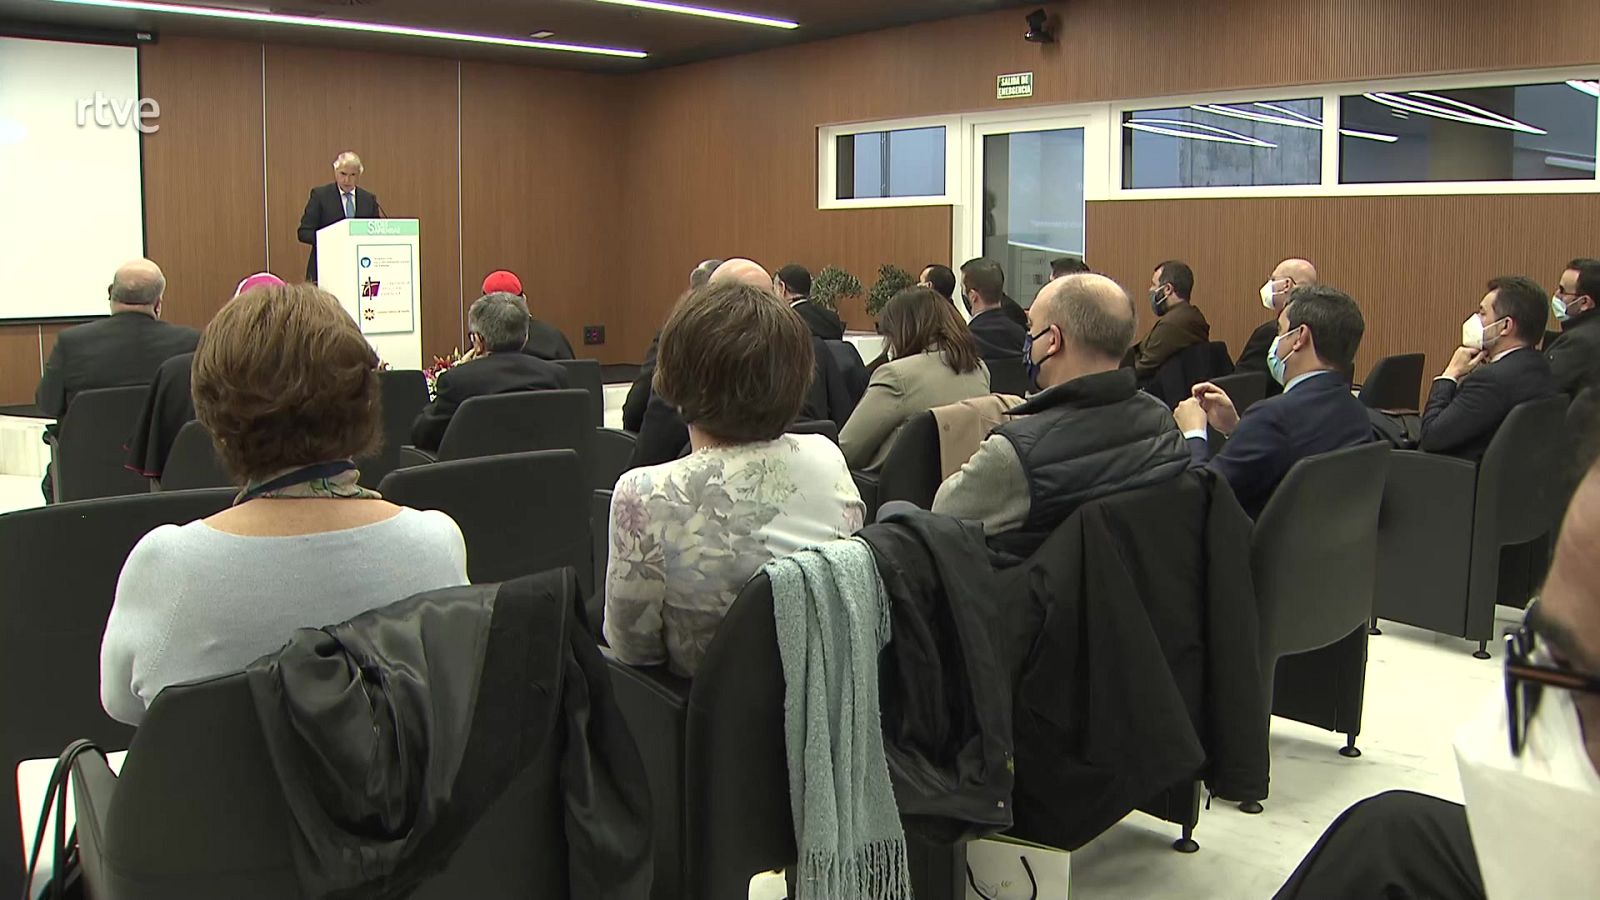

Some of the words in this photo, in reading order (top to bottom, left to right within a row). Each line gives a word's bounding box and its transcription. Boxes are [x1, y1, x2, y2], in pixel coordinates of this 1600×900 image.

[1001, 76, 1020, 86] SALIDA
[1021, 75, 1029, 85] DE
[999, 85, 1031, 96] EMERGENCIA
